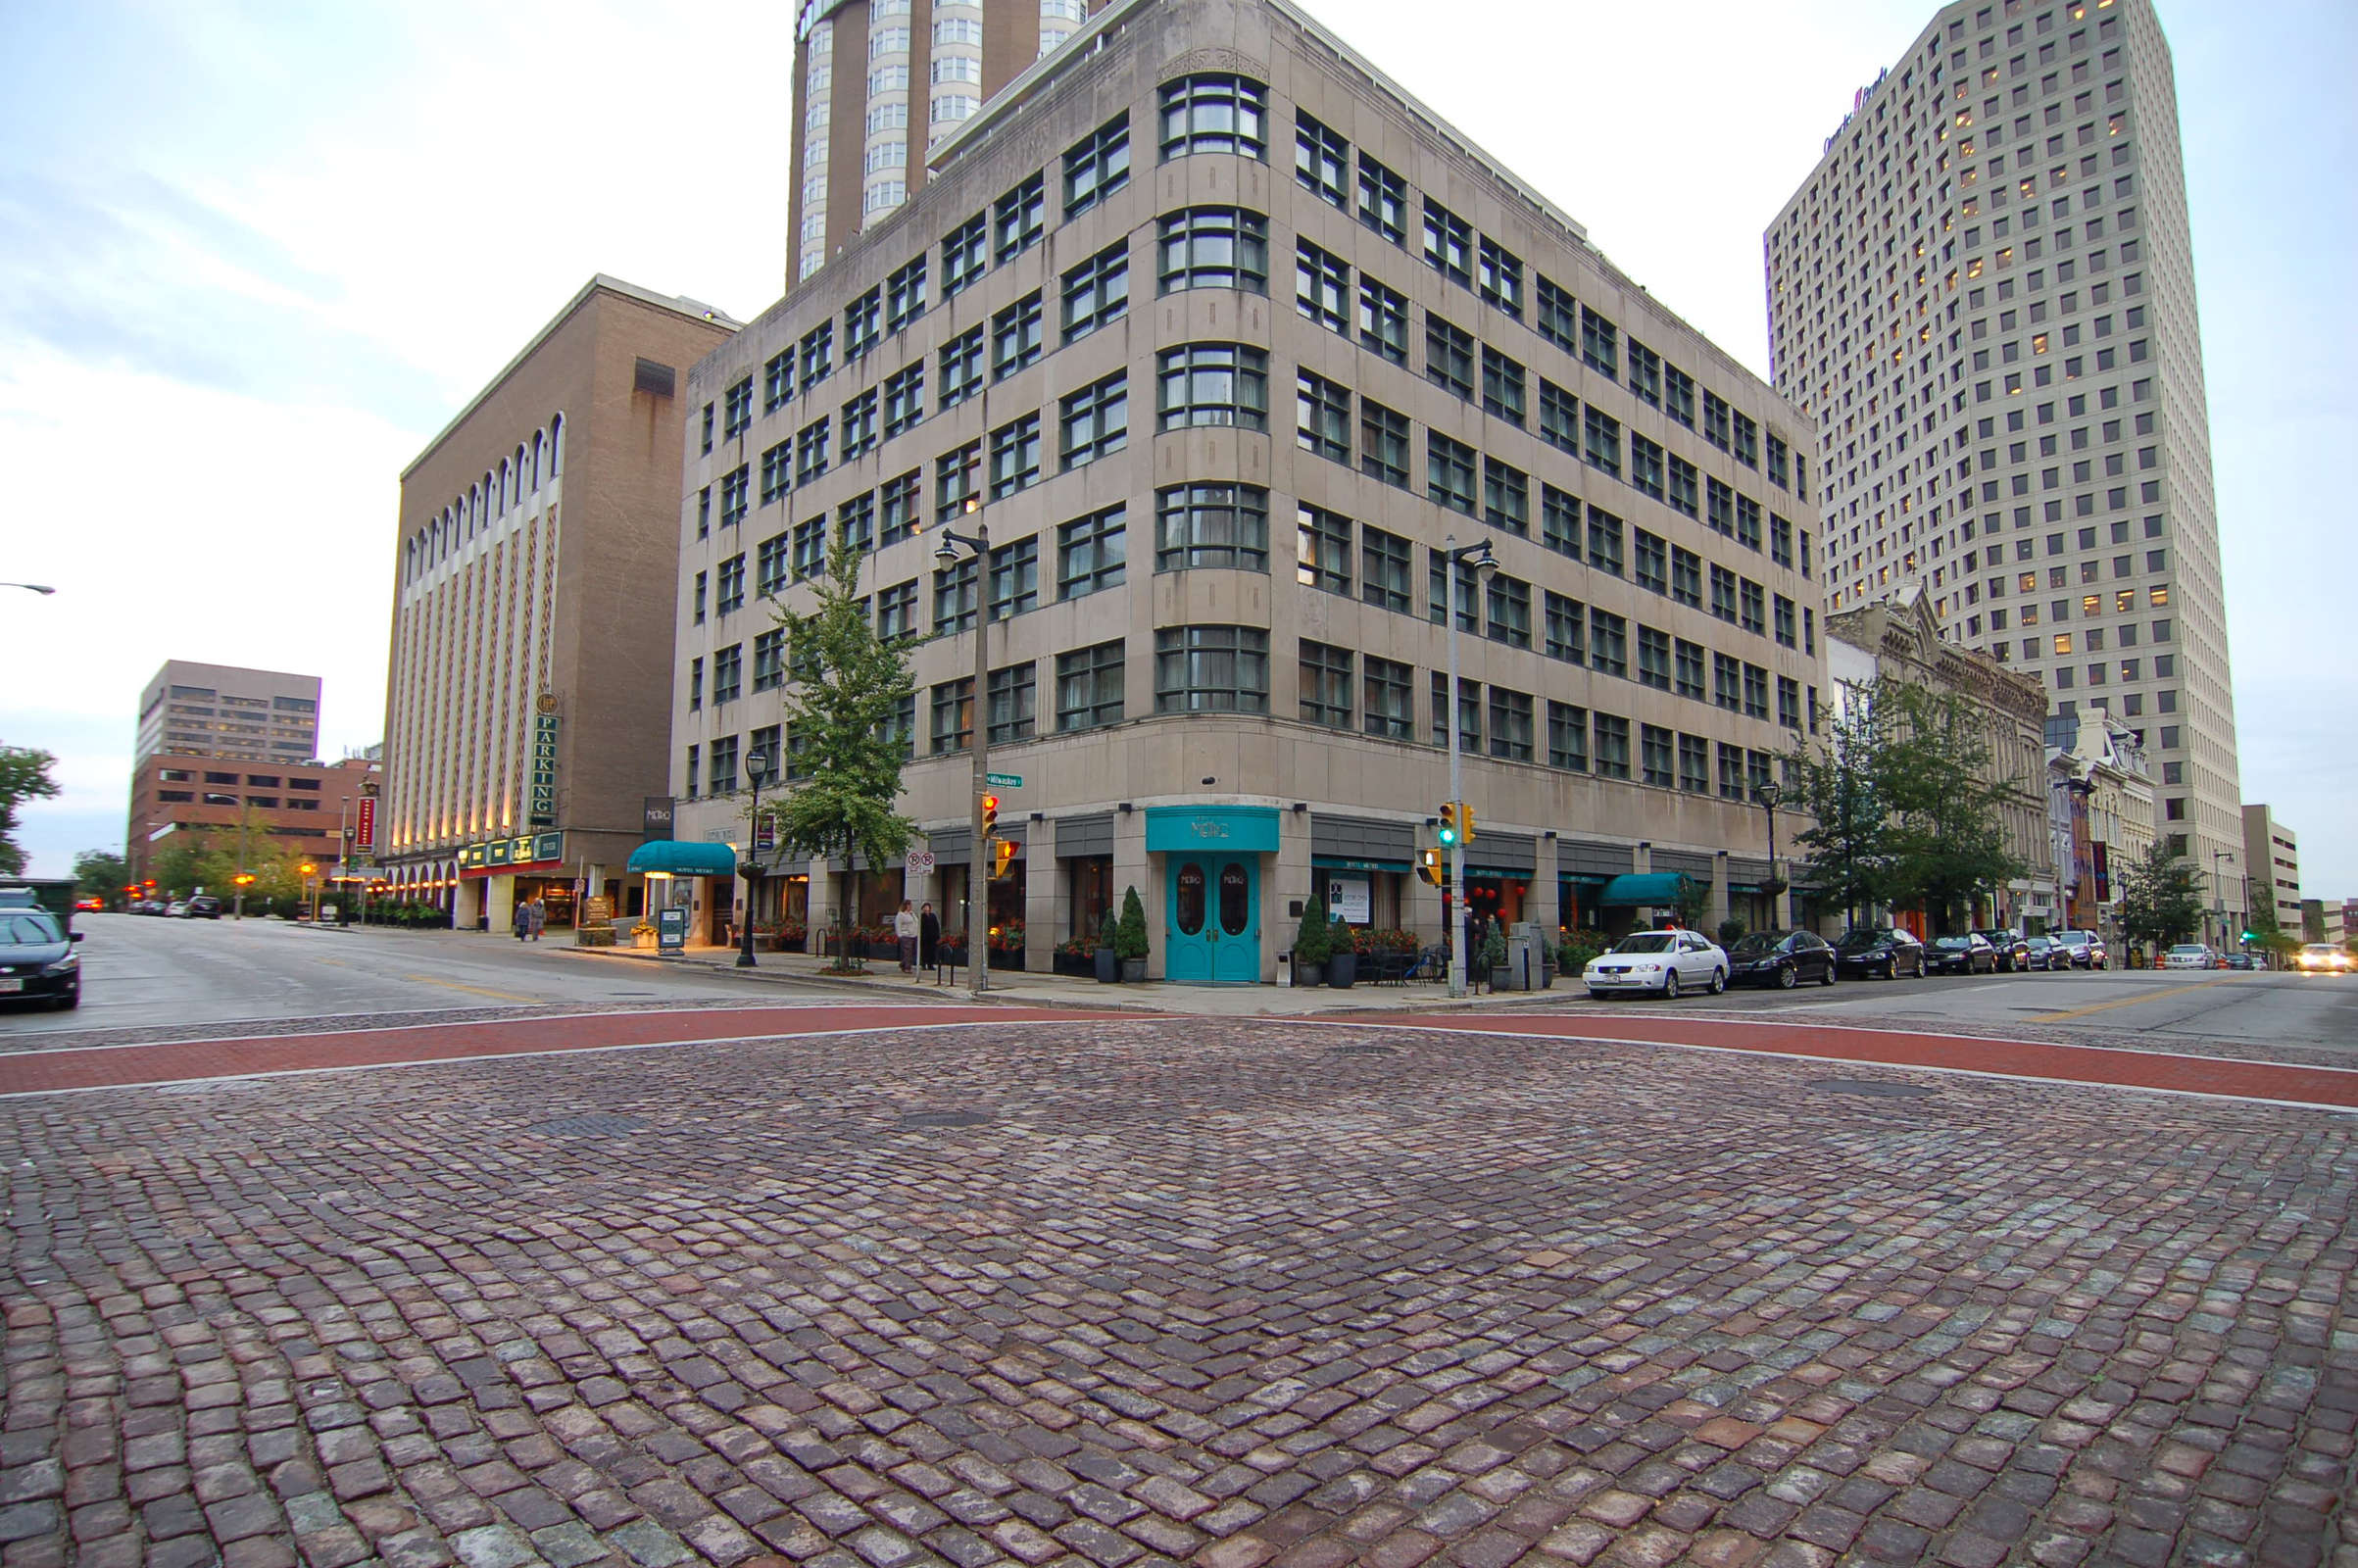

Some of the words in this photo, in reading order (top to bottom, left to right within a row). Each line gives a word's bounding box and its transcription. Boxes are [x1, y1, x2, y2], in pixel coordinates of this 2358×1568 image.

[536, 716, 552, 813] PARKING
[990, 775, 1016, 786] Milwaukee
[647, 809, 671, 821] METRO
[1191, 821, 1231, 839] METRO
